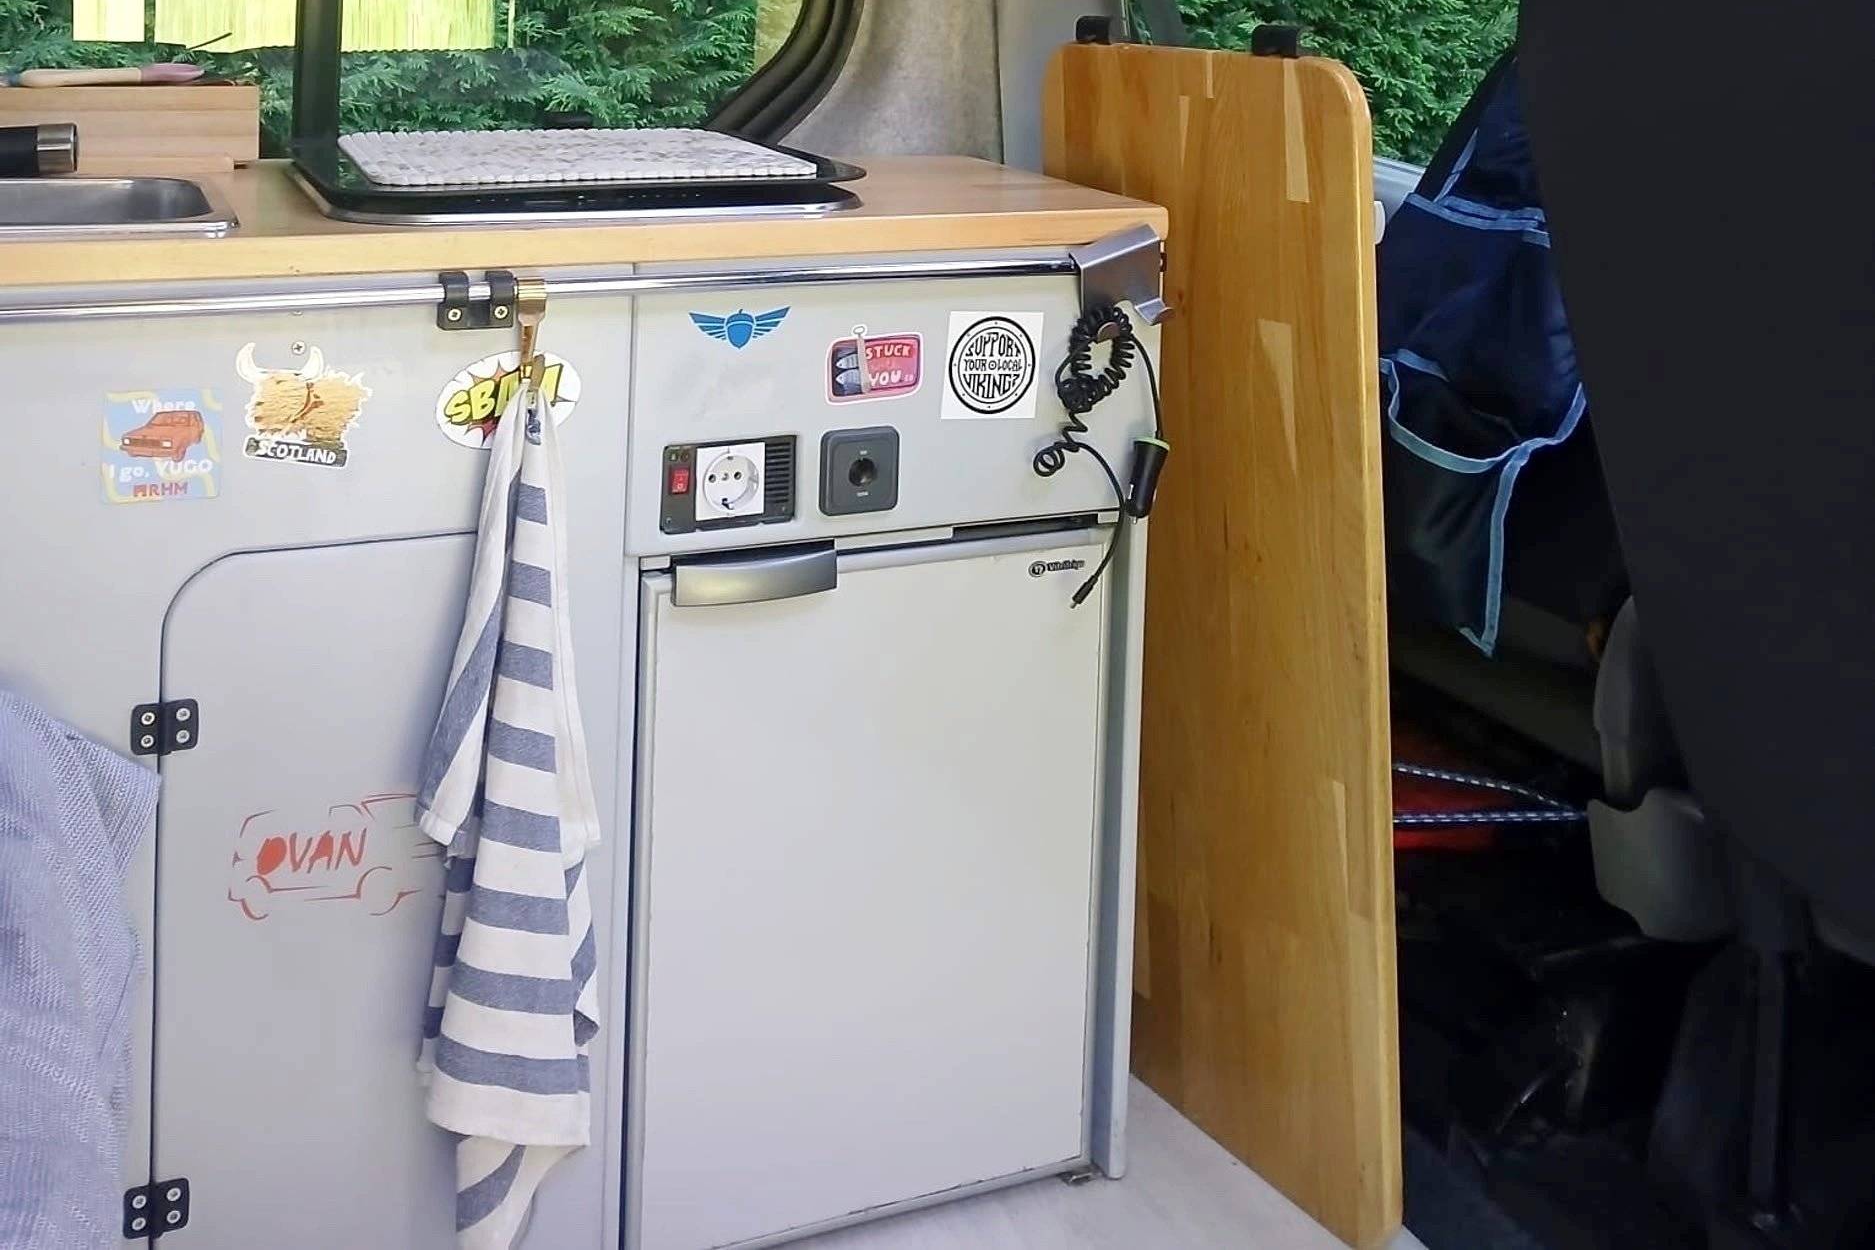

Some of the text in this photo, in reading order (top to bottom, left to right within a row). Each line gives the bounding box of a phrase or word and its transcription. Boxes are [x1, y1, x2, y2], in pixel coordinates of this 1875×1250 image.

[865, 343, 912, 360] STUCK
[965, 331, 1021, 357] SUPPORT
[963, 358, 1023, 372] YOUR LOCAL
[868, 370, 902, 387] YOU
[255, 440, 337, 464] SCOTLAND
[155, 458, 213, 478] YUGO
